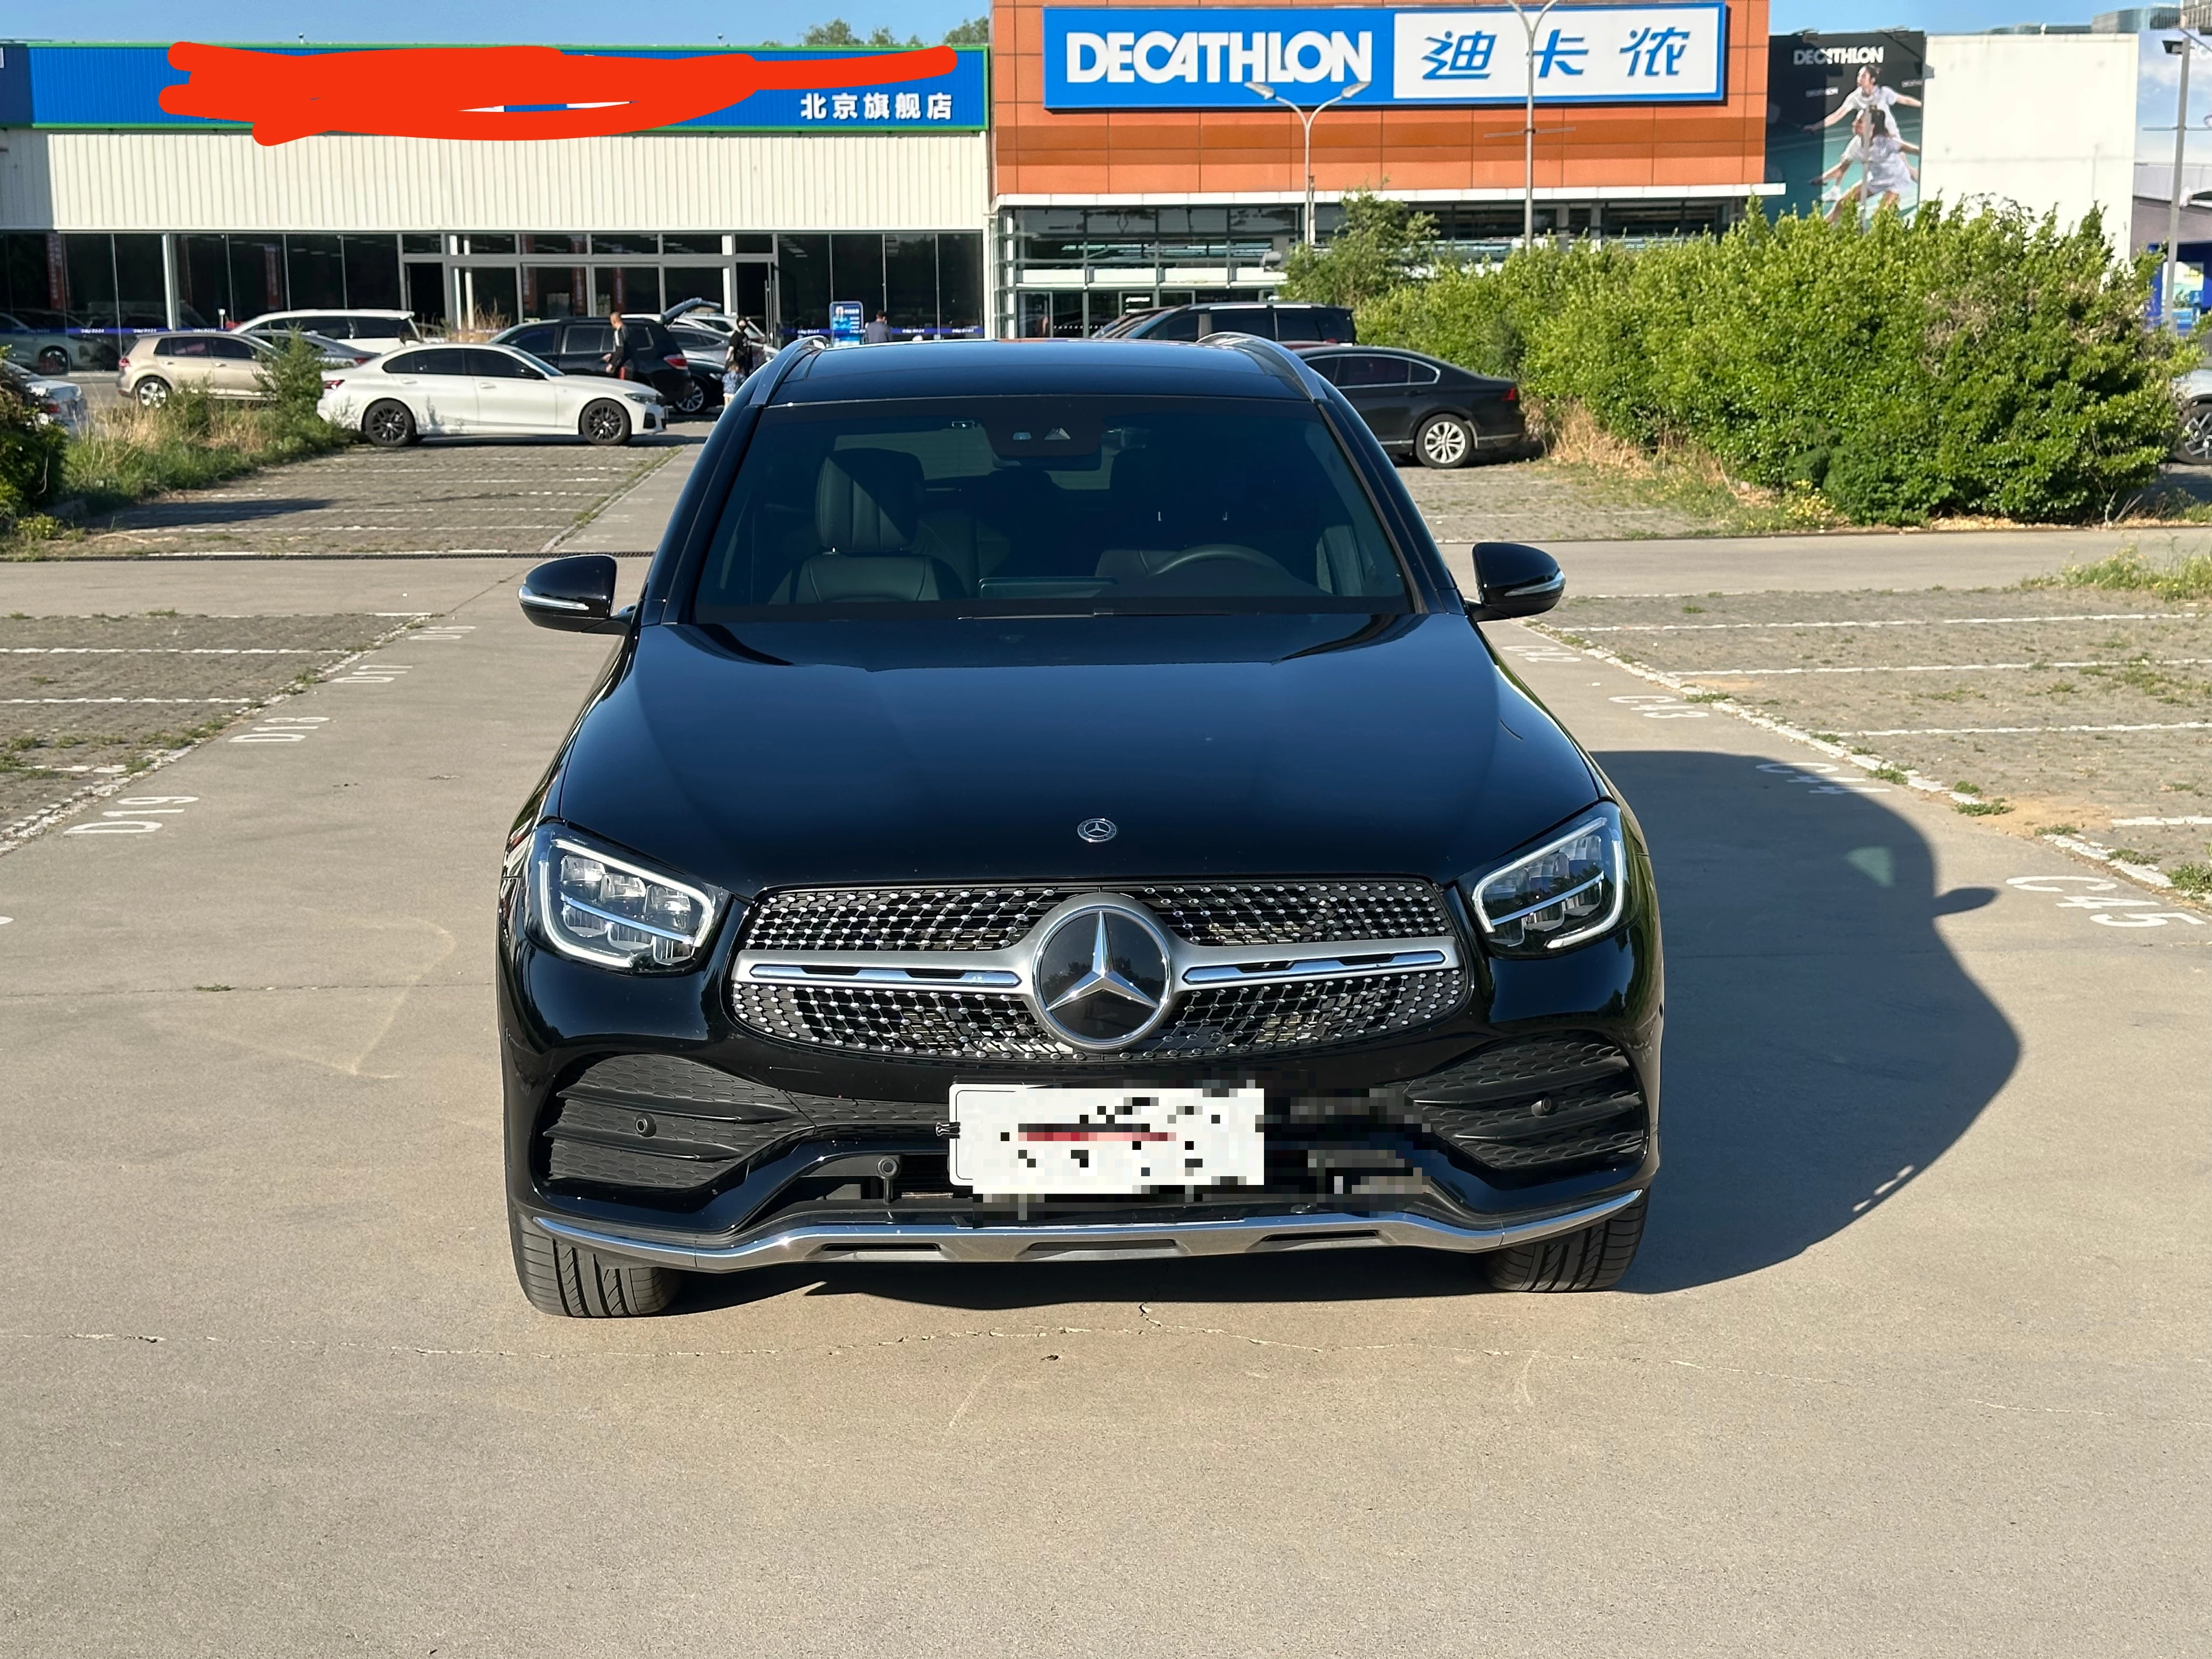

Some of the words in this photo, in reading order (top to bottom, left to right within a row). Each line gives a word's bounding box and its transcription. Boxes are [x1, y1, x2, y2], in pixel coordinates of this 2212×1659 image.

[1066, 31, 1372, 84] DECATHLON
[1421, 26, 1690, 79] 迪卡侬
[800, 92, 952, 120] 北京旗舰店
[1608, 695, 1709, 718] C43
[228, 717, 329, 742] D18
[1756, 762, 1891, 794] C44
[63, 796, 199, 835] D19
[2005, 876, 2206, 927] C45
